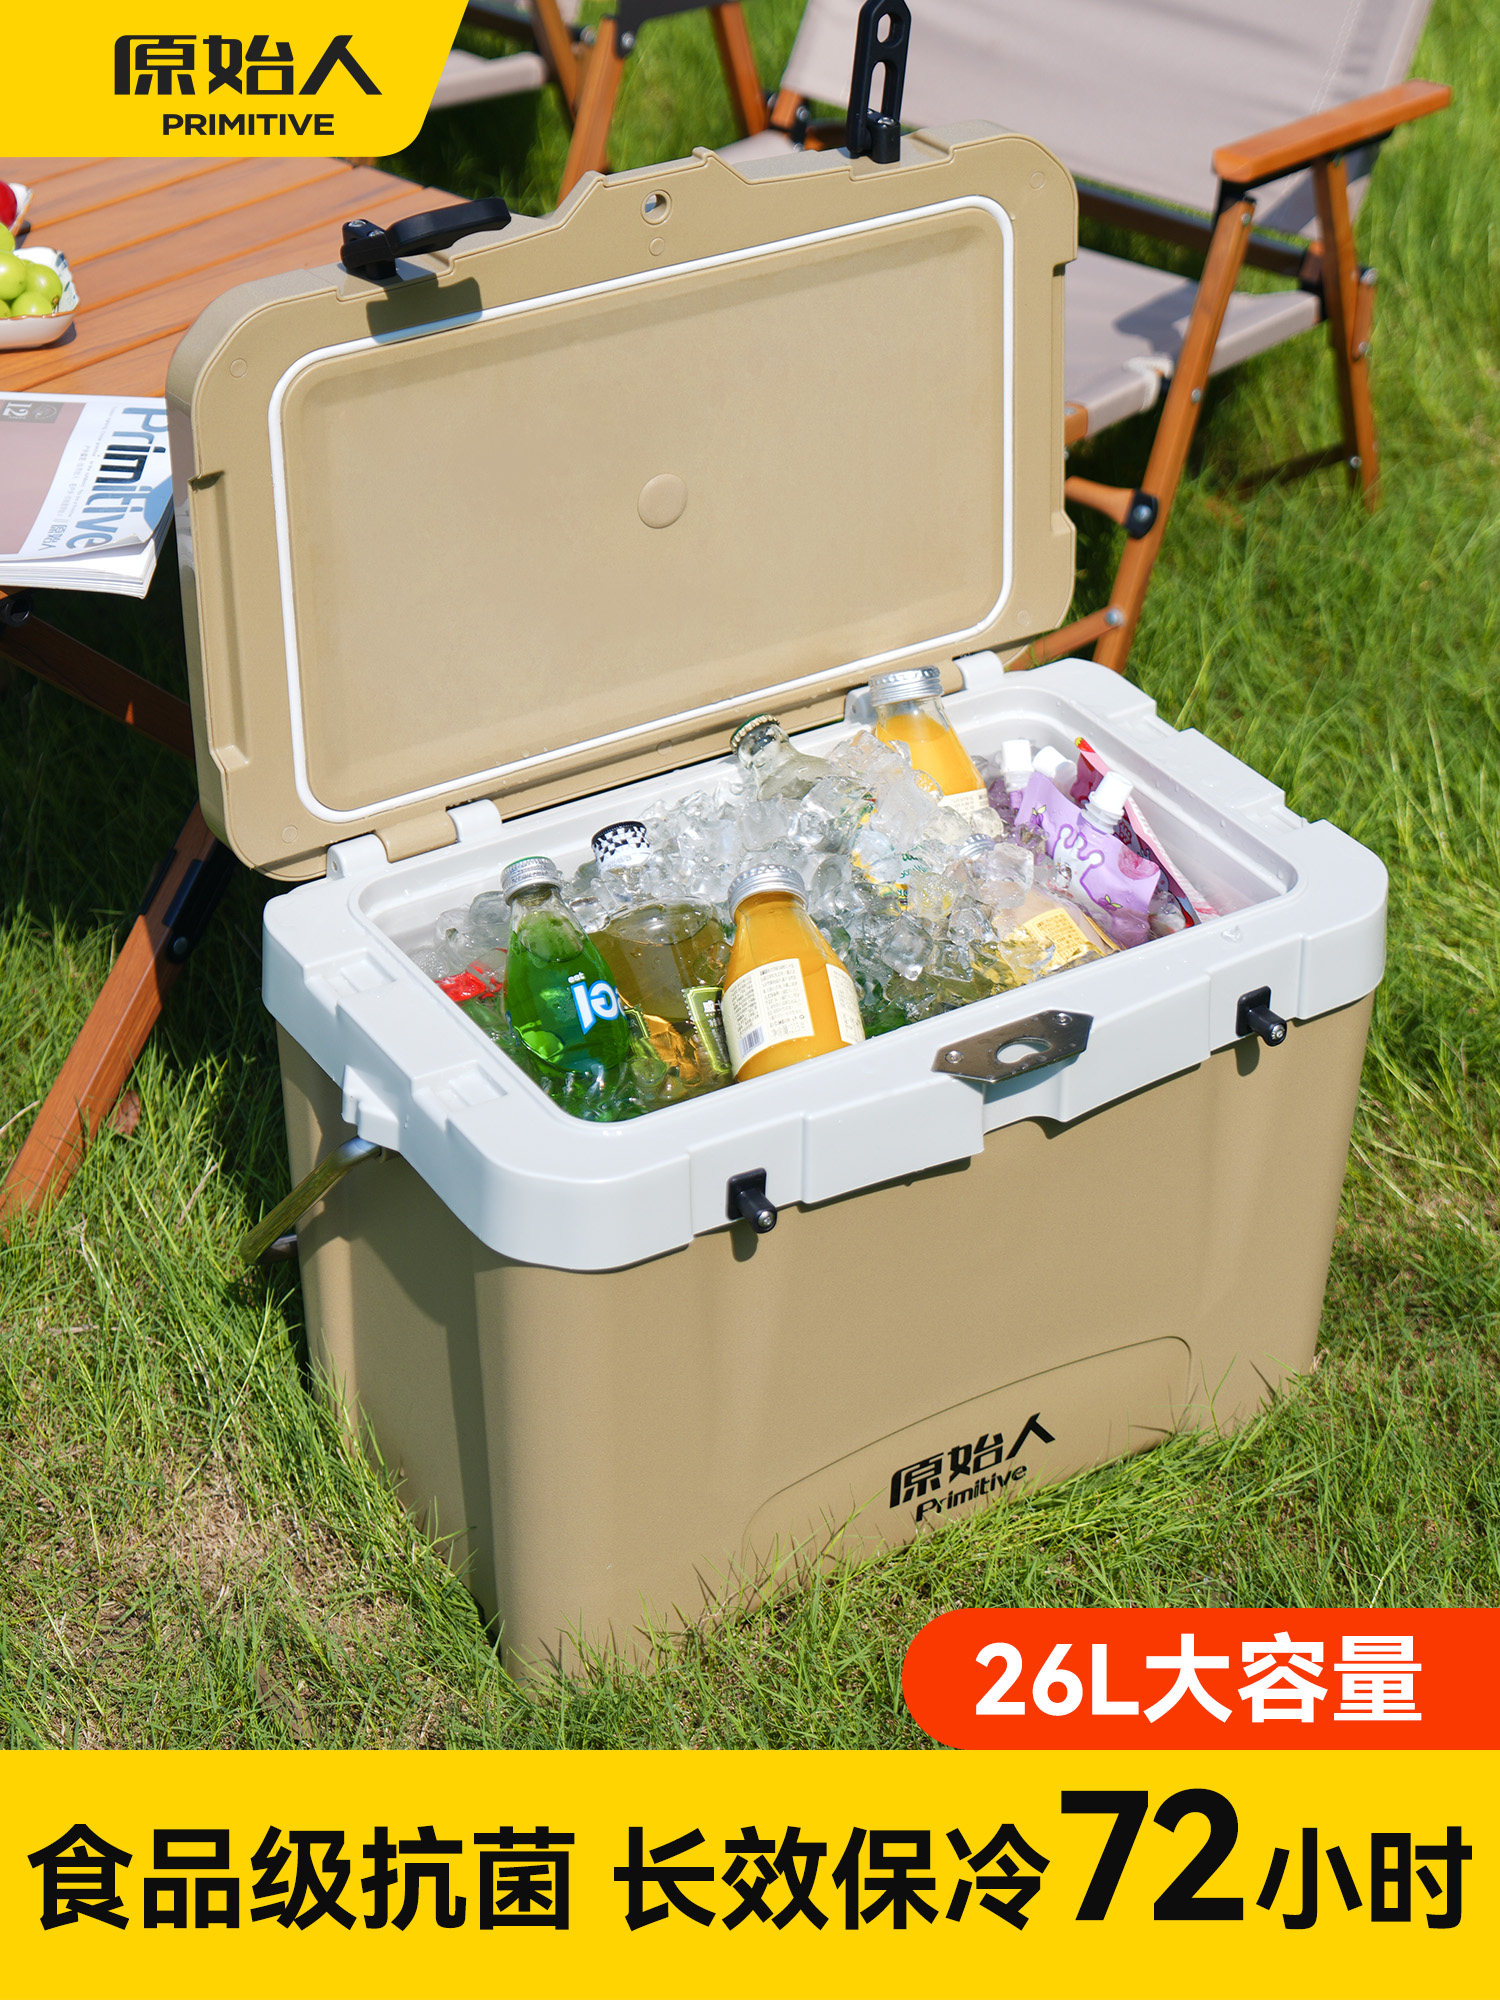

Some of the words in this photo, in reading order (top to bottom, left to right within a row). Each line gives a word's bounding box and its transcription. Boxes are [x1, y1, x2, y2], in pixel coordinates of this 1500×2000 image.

[65, 406, 168, 550] Primitive
[889, 1412, 1056, 1509] 原始人
[916, 1464, 1028, 1523] Primitive
